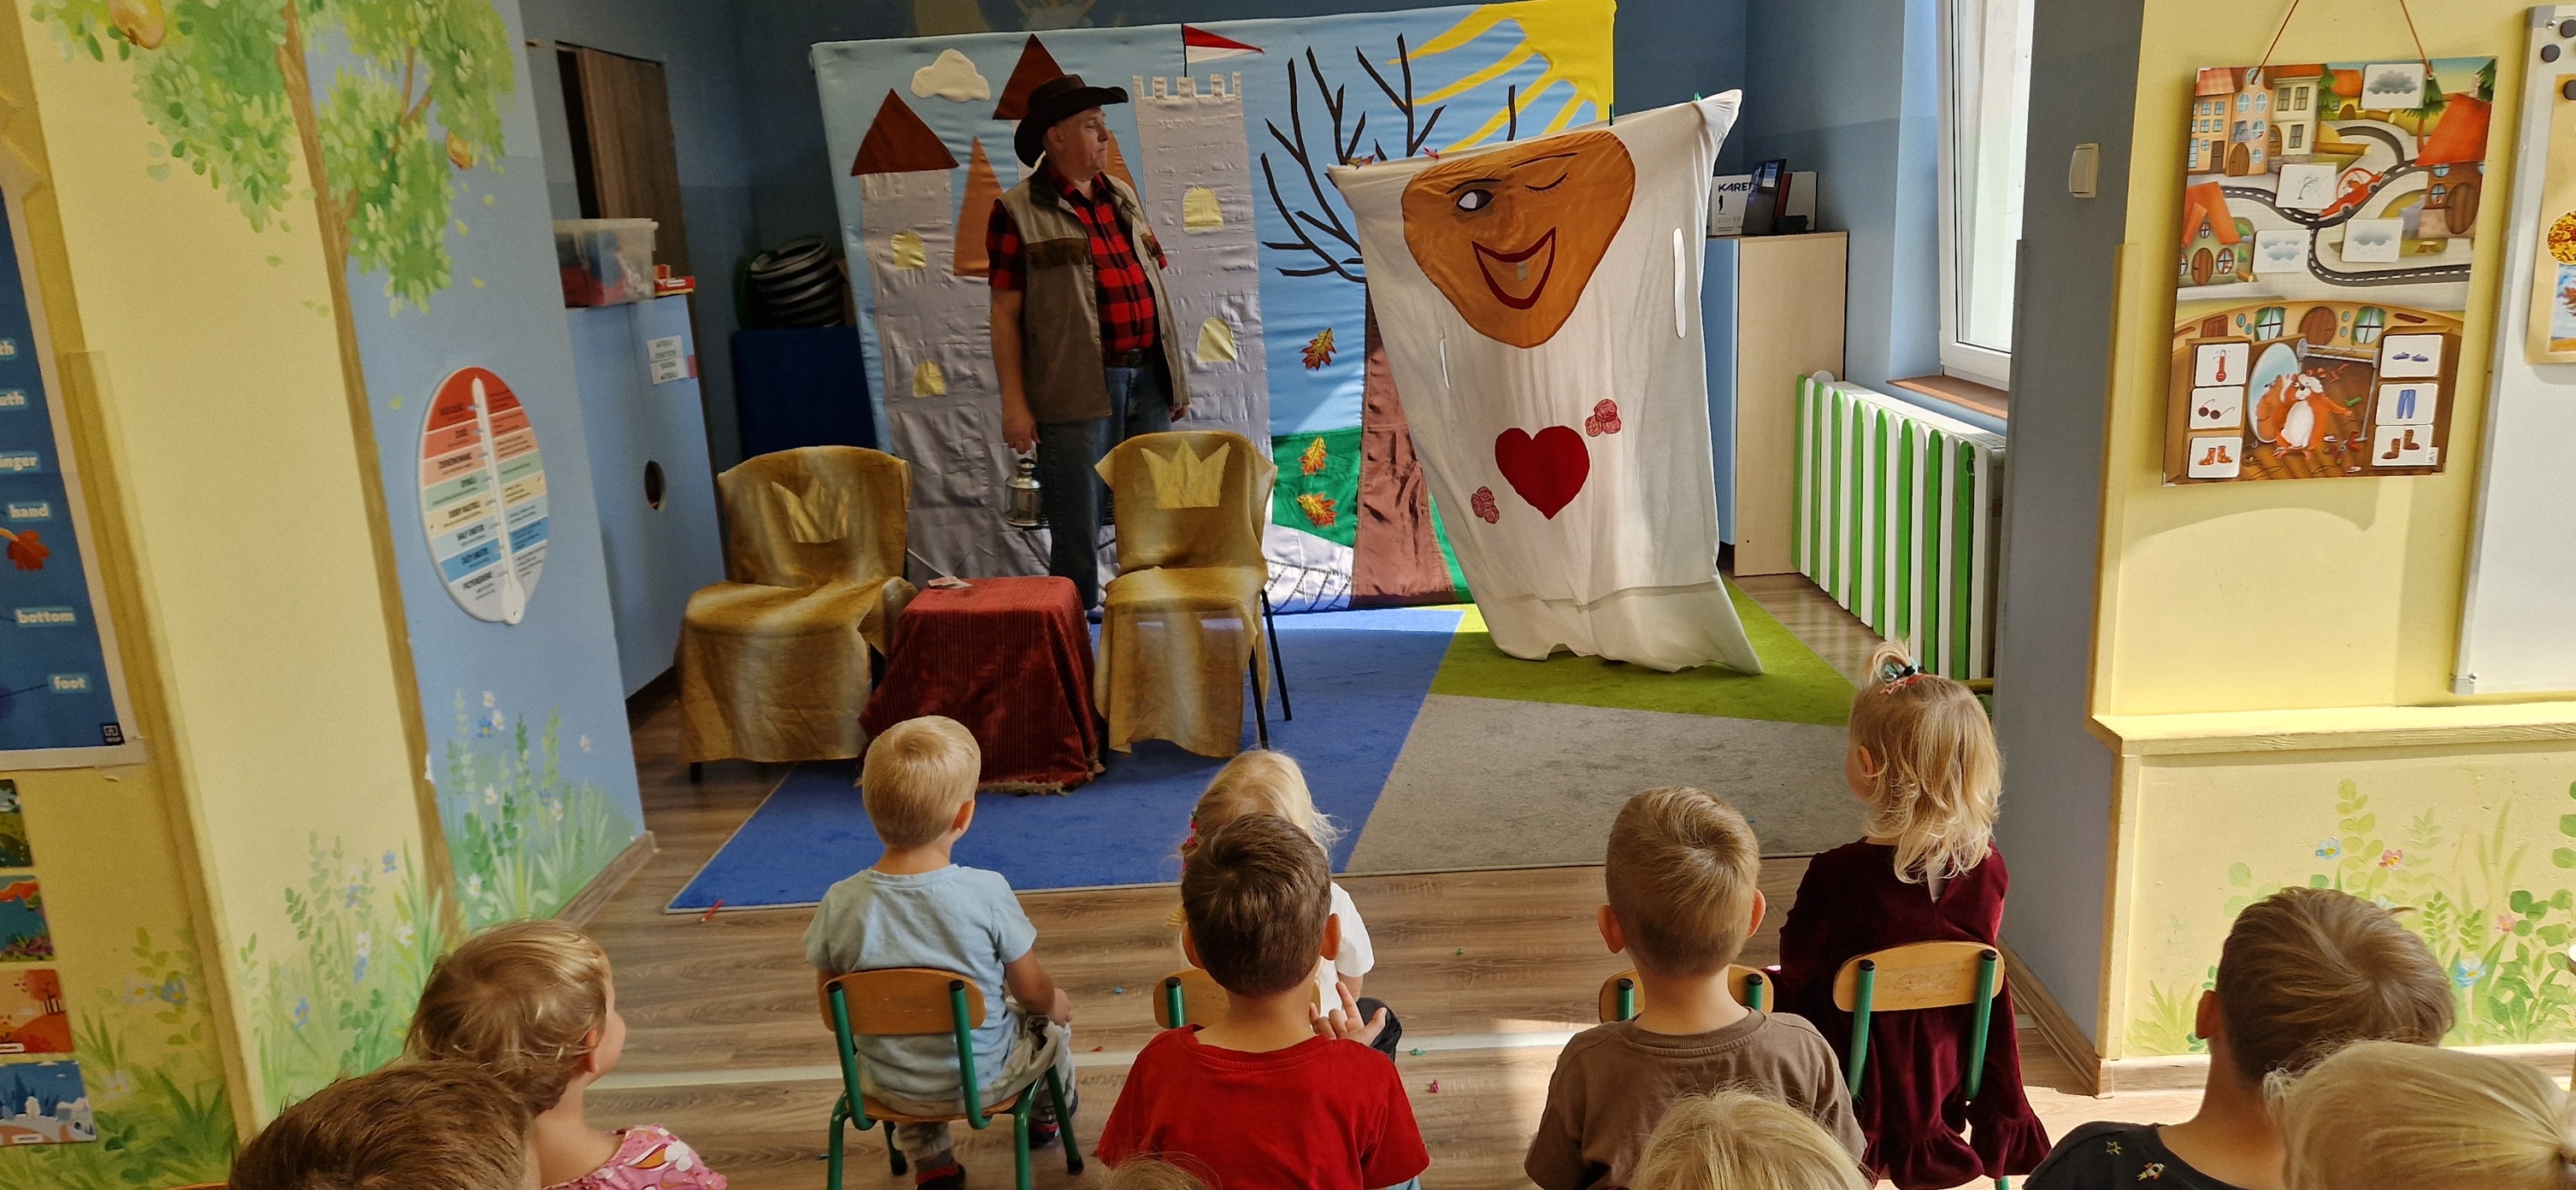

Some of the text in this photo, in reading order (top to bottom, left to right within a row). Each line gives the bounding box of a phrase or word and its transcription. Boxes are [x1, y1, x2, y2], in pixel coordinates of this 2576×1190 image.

[9, 503, 50, 519] hand
[16, 609, 74, 624] bottom
[53, 675, 85, 690] foot
